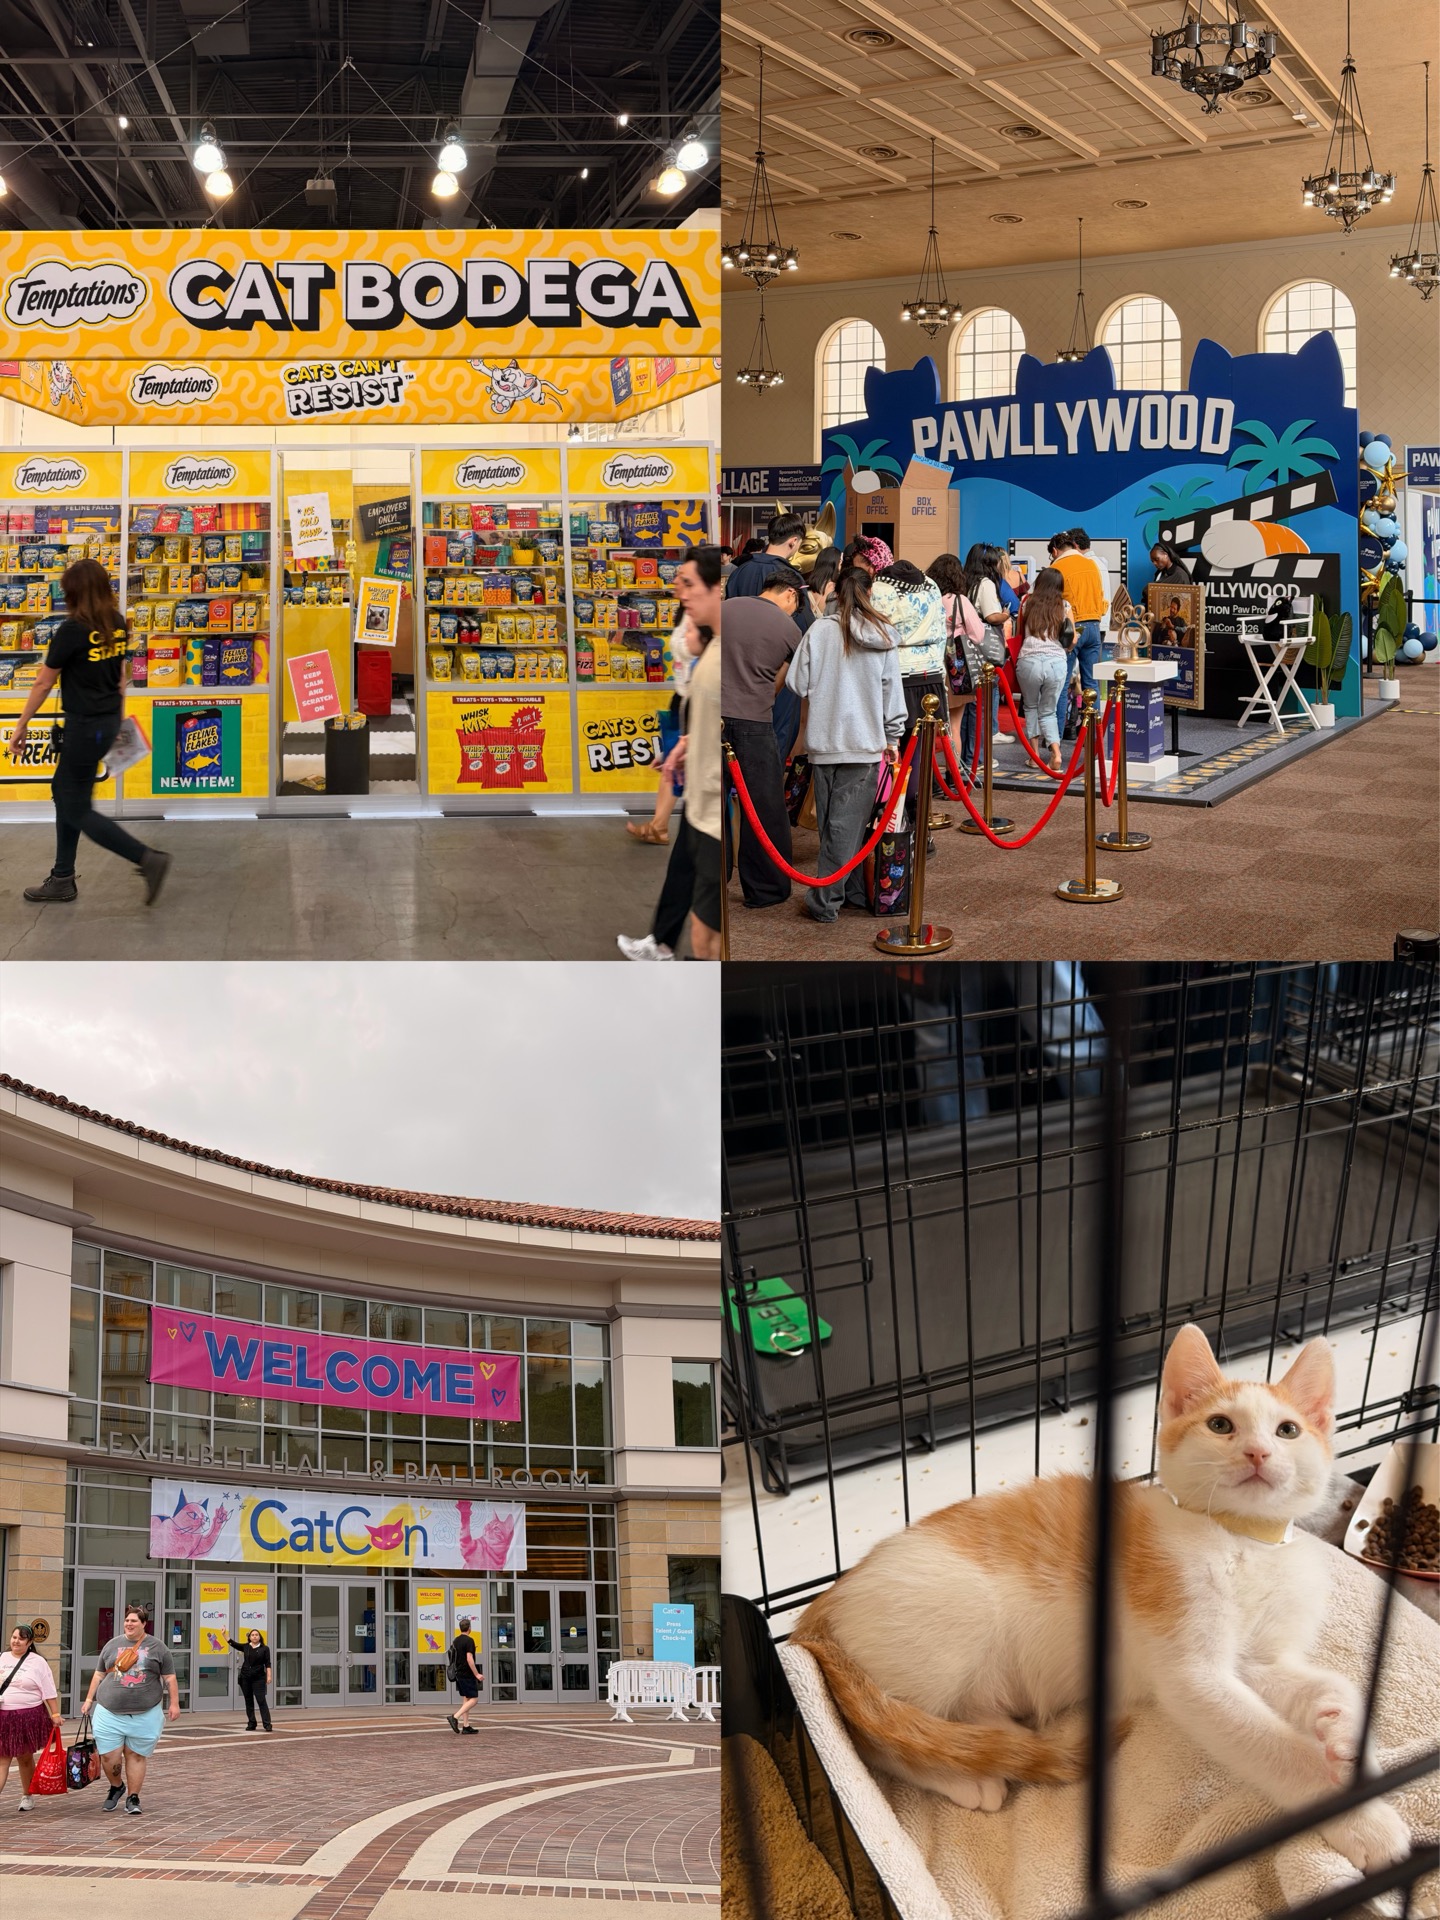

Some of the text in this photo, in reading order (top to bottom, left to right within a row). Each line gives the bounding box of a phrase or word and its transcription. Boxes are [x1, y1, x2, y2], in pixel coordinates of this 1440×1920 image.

[17, 279, 139, 317] Temptations
[169, 259, 702, 331] CAT BODEGA
[284, 363, 337, 385] CATS
[138, 375, 214, 398] Temptations
[288, 376, 403, 415] RESIST
[912, 394, 1235, 463] PAWLLYWOOD
[21, 467, 82, 486] Temptations
[172, 466, 231, 485] Temptations
[462, 464, 521, 484] Temptations
[609, 463, 669, 482] Temptations
[722, 470, 770, 494] LLAGE
[871, 495, 885, 505] BOX
[916, 496, 931, 506] BOX
[368, 502, 407, 518] EMPLOYEES
[636, 512, 657, 520] FELINE
[866, 505, 889, 515] OFFICE
[911, 506, 937, 516] OFFICE
[378, 513, 397, 525] ONLY!
[635, 519, 658, 527] FLAKES
[1232, 604, 1250, 614] Paw
[1251, 605, 1268, 614] Pro
[1204, 622, 1235, 632] CatCon
[224, 648, 247, 657] FELINE
[222, 655, 248, 664] FLAKES
[303, 670, 321, 680] KEEP
[304, 679, 324, 688] CALM
[308, 688, 324, 696] AND
[302, 694, 334, 707] SCRATCH
[461, 708, 489, 721] WHISK
[463, 715, 494, 735] MIX
[516, 717, 523, 726] 2
[583, 716, 637, 740] CATS
[187, 726, 217, 742] FELINE
[186, 735, 218, 752] FLAKES
[488, 745, 515, 754] WHISK
[494, 753, 511, 761] MIX
[587, 735, 663, 772] RESI
[160, 776, 235, 788] NEW ITEM!
[203, 1330, 476, 1405] WELCOME
[107, 1431, 590, 1492] EXHIBIT HALL & BALLROOM
[250, 1499, 429, 1557] CatCon
[202, 1611, 227, 1619] CatCon
[241, 1611, 265, 1619] CatCon
[419, 1613, 443, 1621] CatCon
